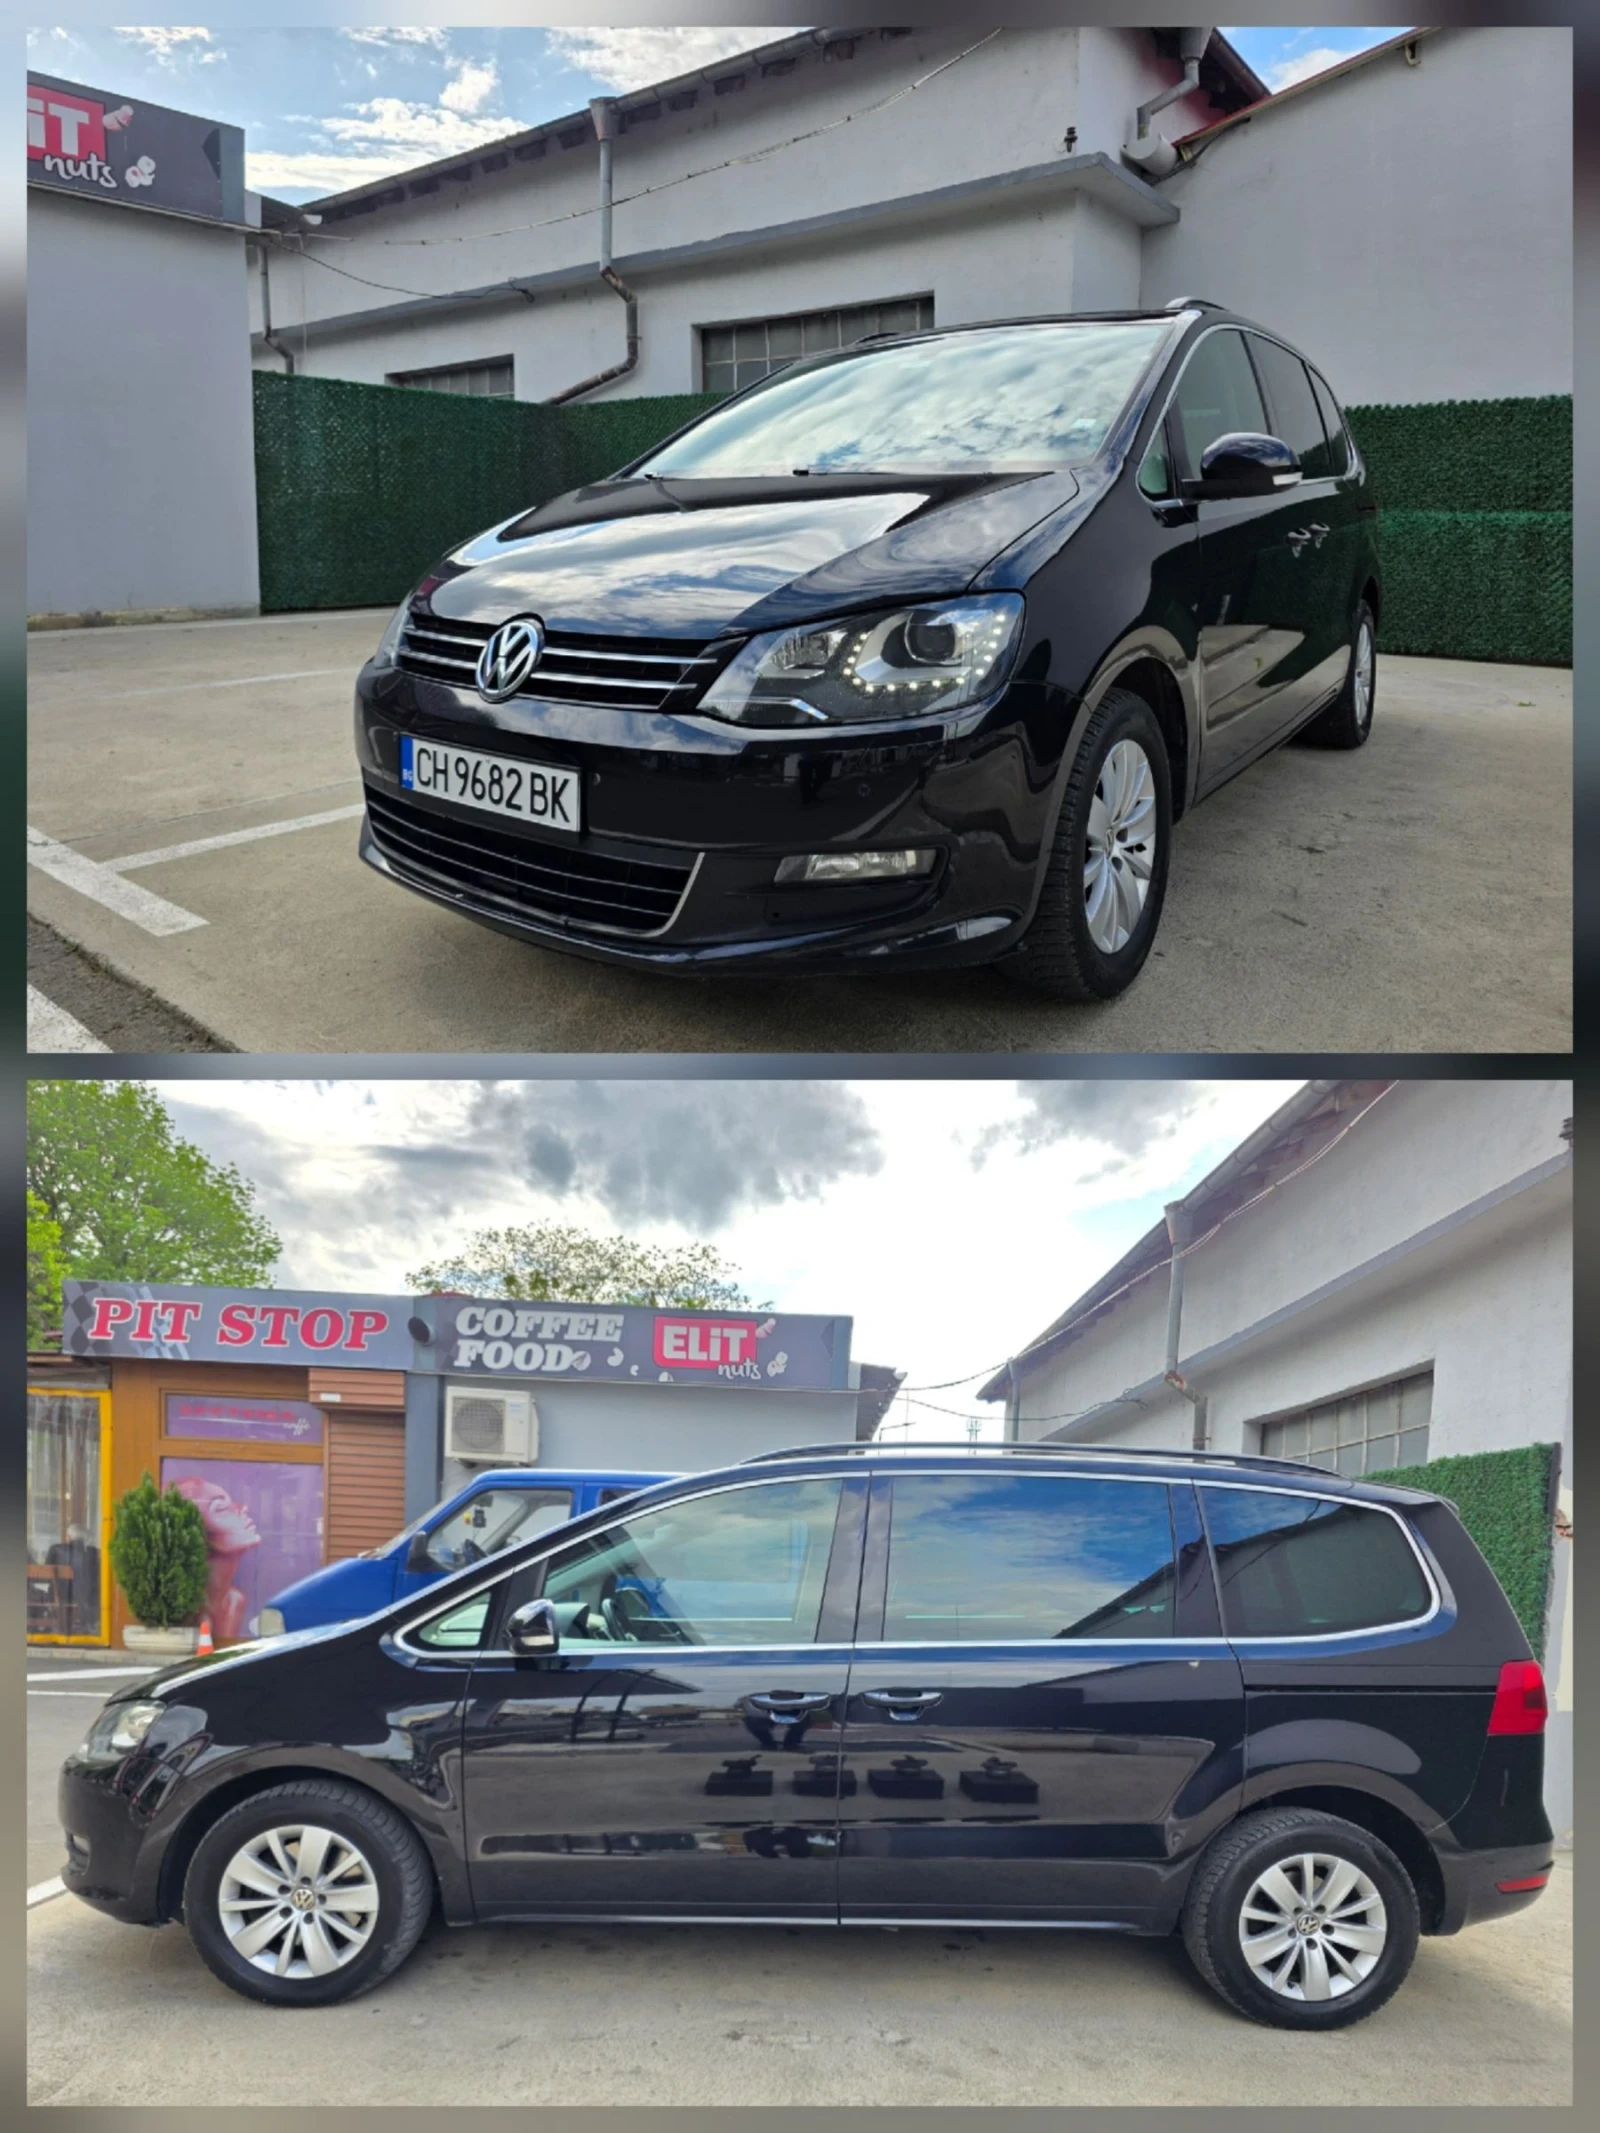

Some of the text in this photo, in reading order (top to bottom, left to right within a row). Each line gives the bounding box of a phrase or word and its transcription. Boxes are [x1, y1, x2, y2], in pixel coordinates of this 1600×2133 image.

[44, 151, 118, 189] nuts
[89, 1297, 389, 1351] PIT STOP
[455, 1306, 625, 1343] COFFEE
[453, 1339, 573, 1372] FOOD
[717, 1358, 761, 1380] nuts
